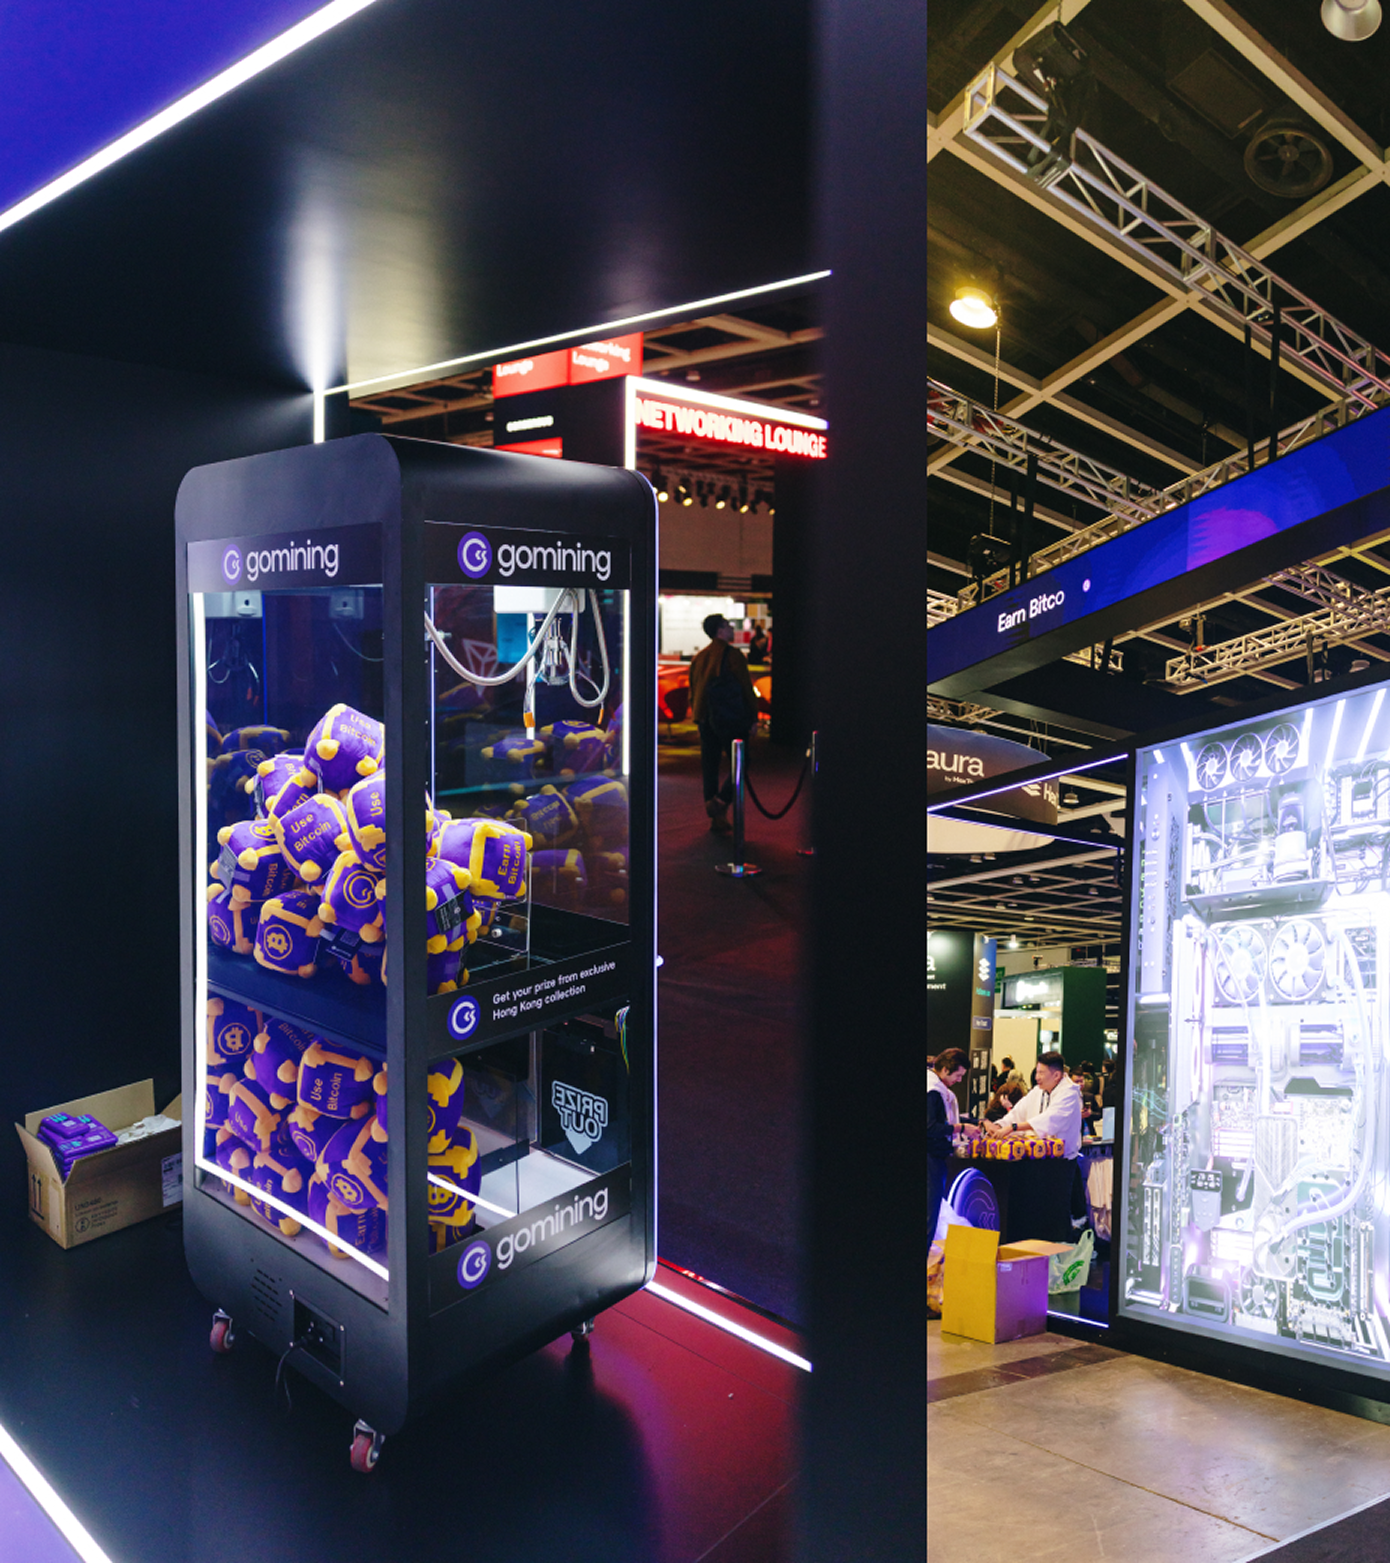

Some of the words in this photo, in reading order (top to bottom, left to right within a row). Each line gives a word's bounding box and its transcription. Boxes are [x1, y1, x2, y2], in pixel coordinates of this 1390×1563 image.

[634, 397, 763, 447] NETWORKING
[765, 423, 828, 459] LOUNGE
[246, 540, 340, 581] gomining
[497, 542, 611, 581] gomining
[997, 608, 1026, 632] Earn
[1029, 590, 1065, 618] Bitco
[339, 724, 377, 747] Bitcoin
[349, 713, 372, 730] Use
[370, 791, 384, 817] Use
[290, 813, 315, 834] Use
[293, 820, 332, 852] Bitcoin
[498, 844, 511, 876] Earn
[508, 840, 522, 885] Bitcoin
[493, 990, 510, 1005] Get
[513, 986, 533, 1000] your
[534, 978, 556, 994] prize
[558, 972, 578, 986] from
[580, 960, 616, 978] exclusive
[493, 1006, 518, 1021] Hong
[519, 997, 543, 1012] Kong
[544, 984, 586, 1004] collection
[310, 1078, 323, 1101] Use
[327, 1072, 343, 1112] Bitcoin
[497, 1187, 609, 1270] gomining
